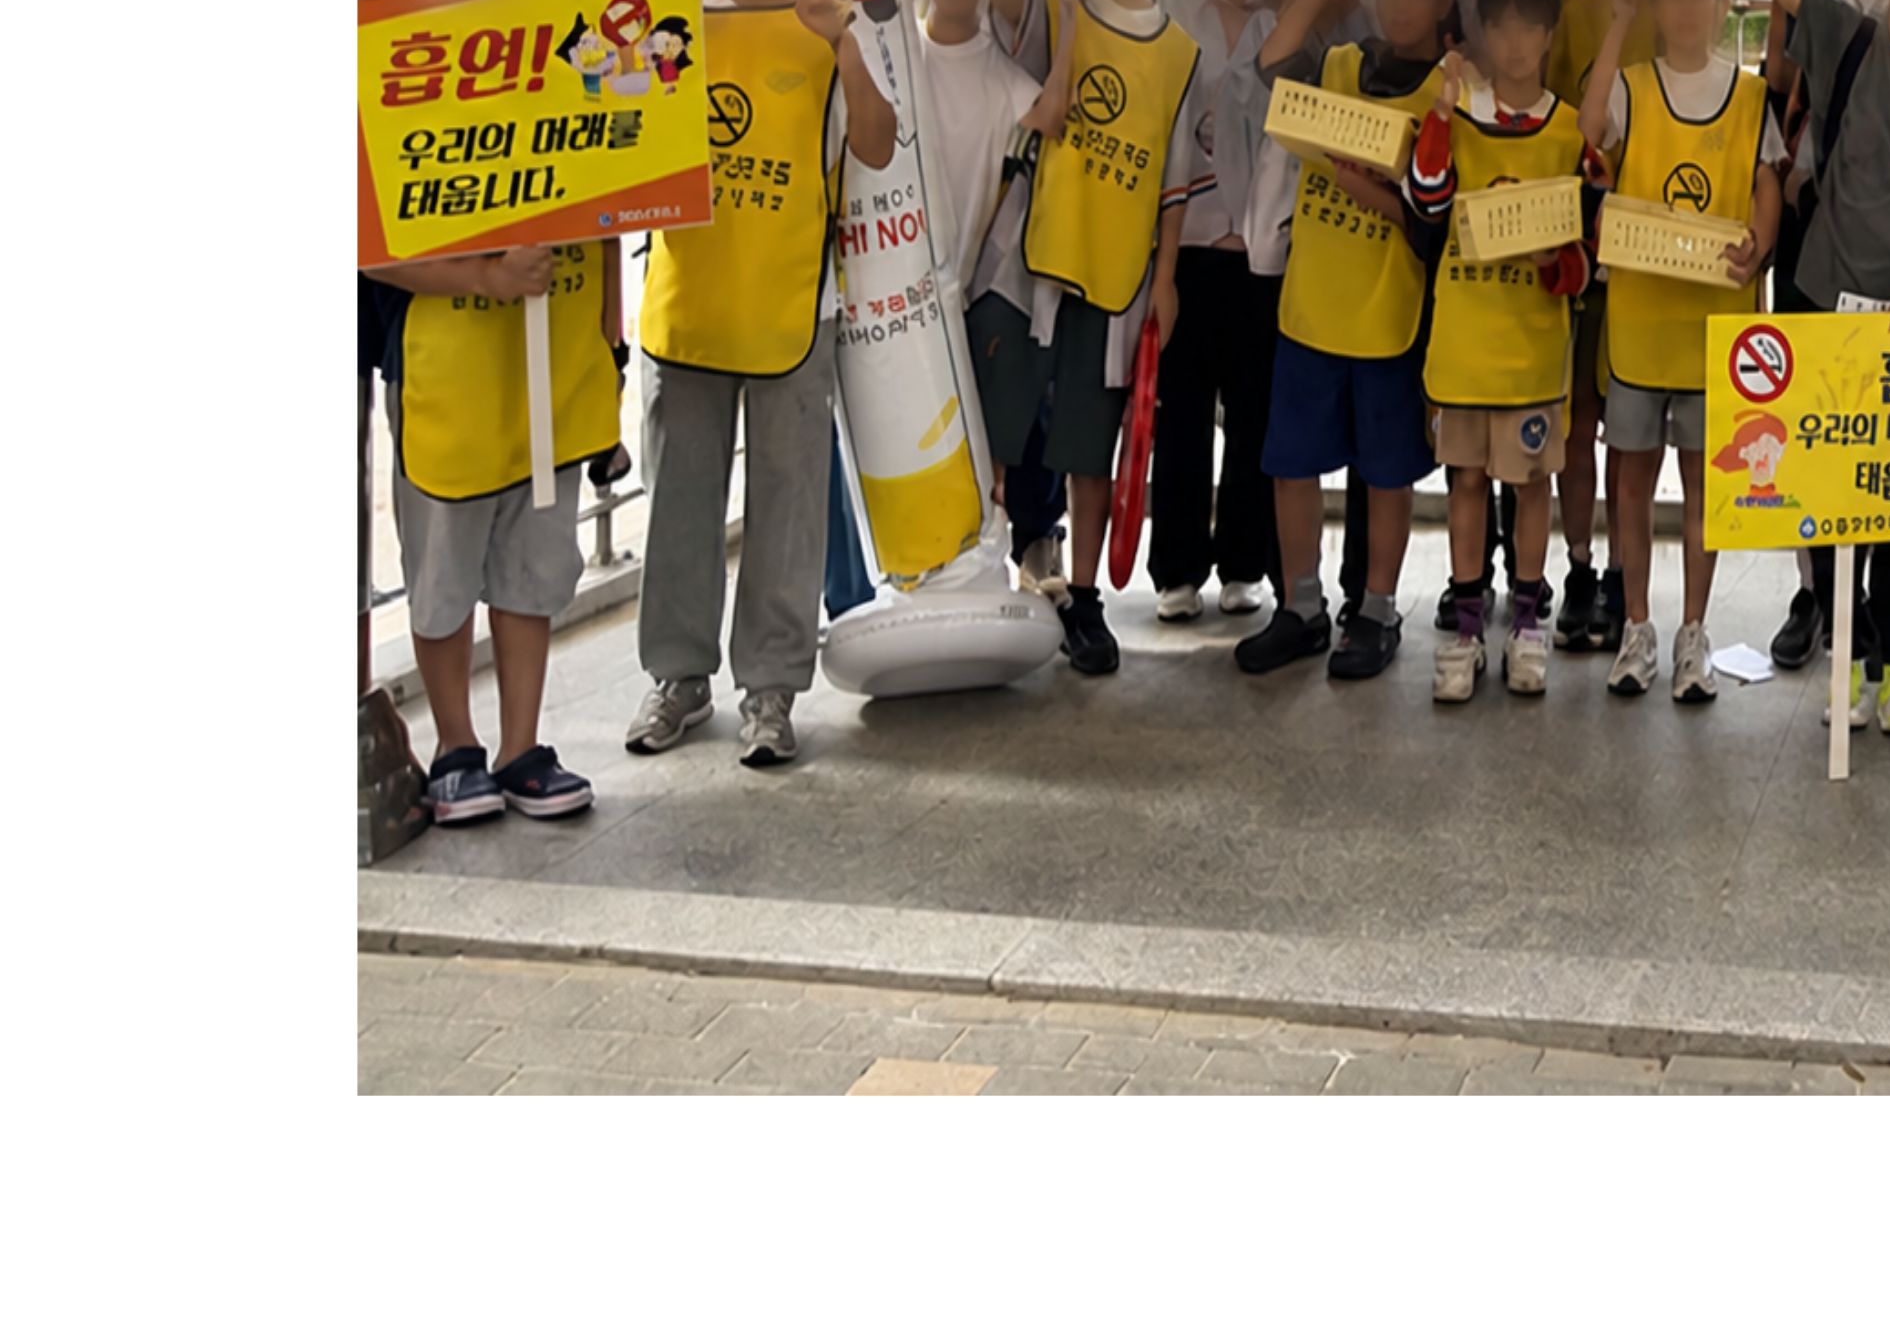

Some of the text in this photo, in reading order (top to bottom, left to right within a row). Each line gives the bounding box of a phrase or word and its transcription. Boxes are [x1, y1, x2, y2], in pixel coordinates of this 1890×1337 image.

[380, 23, 555, 108] 흡연!
[398, 120, 518, 171] 우리의
[1796, 413, 1879, 451] 우리의
